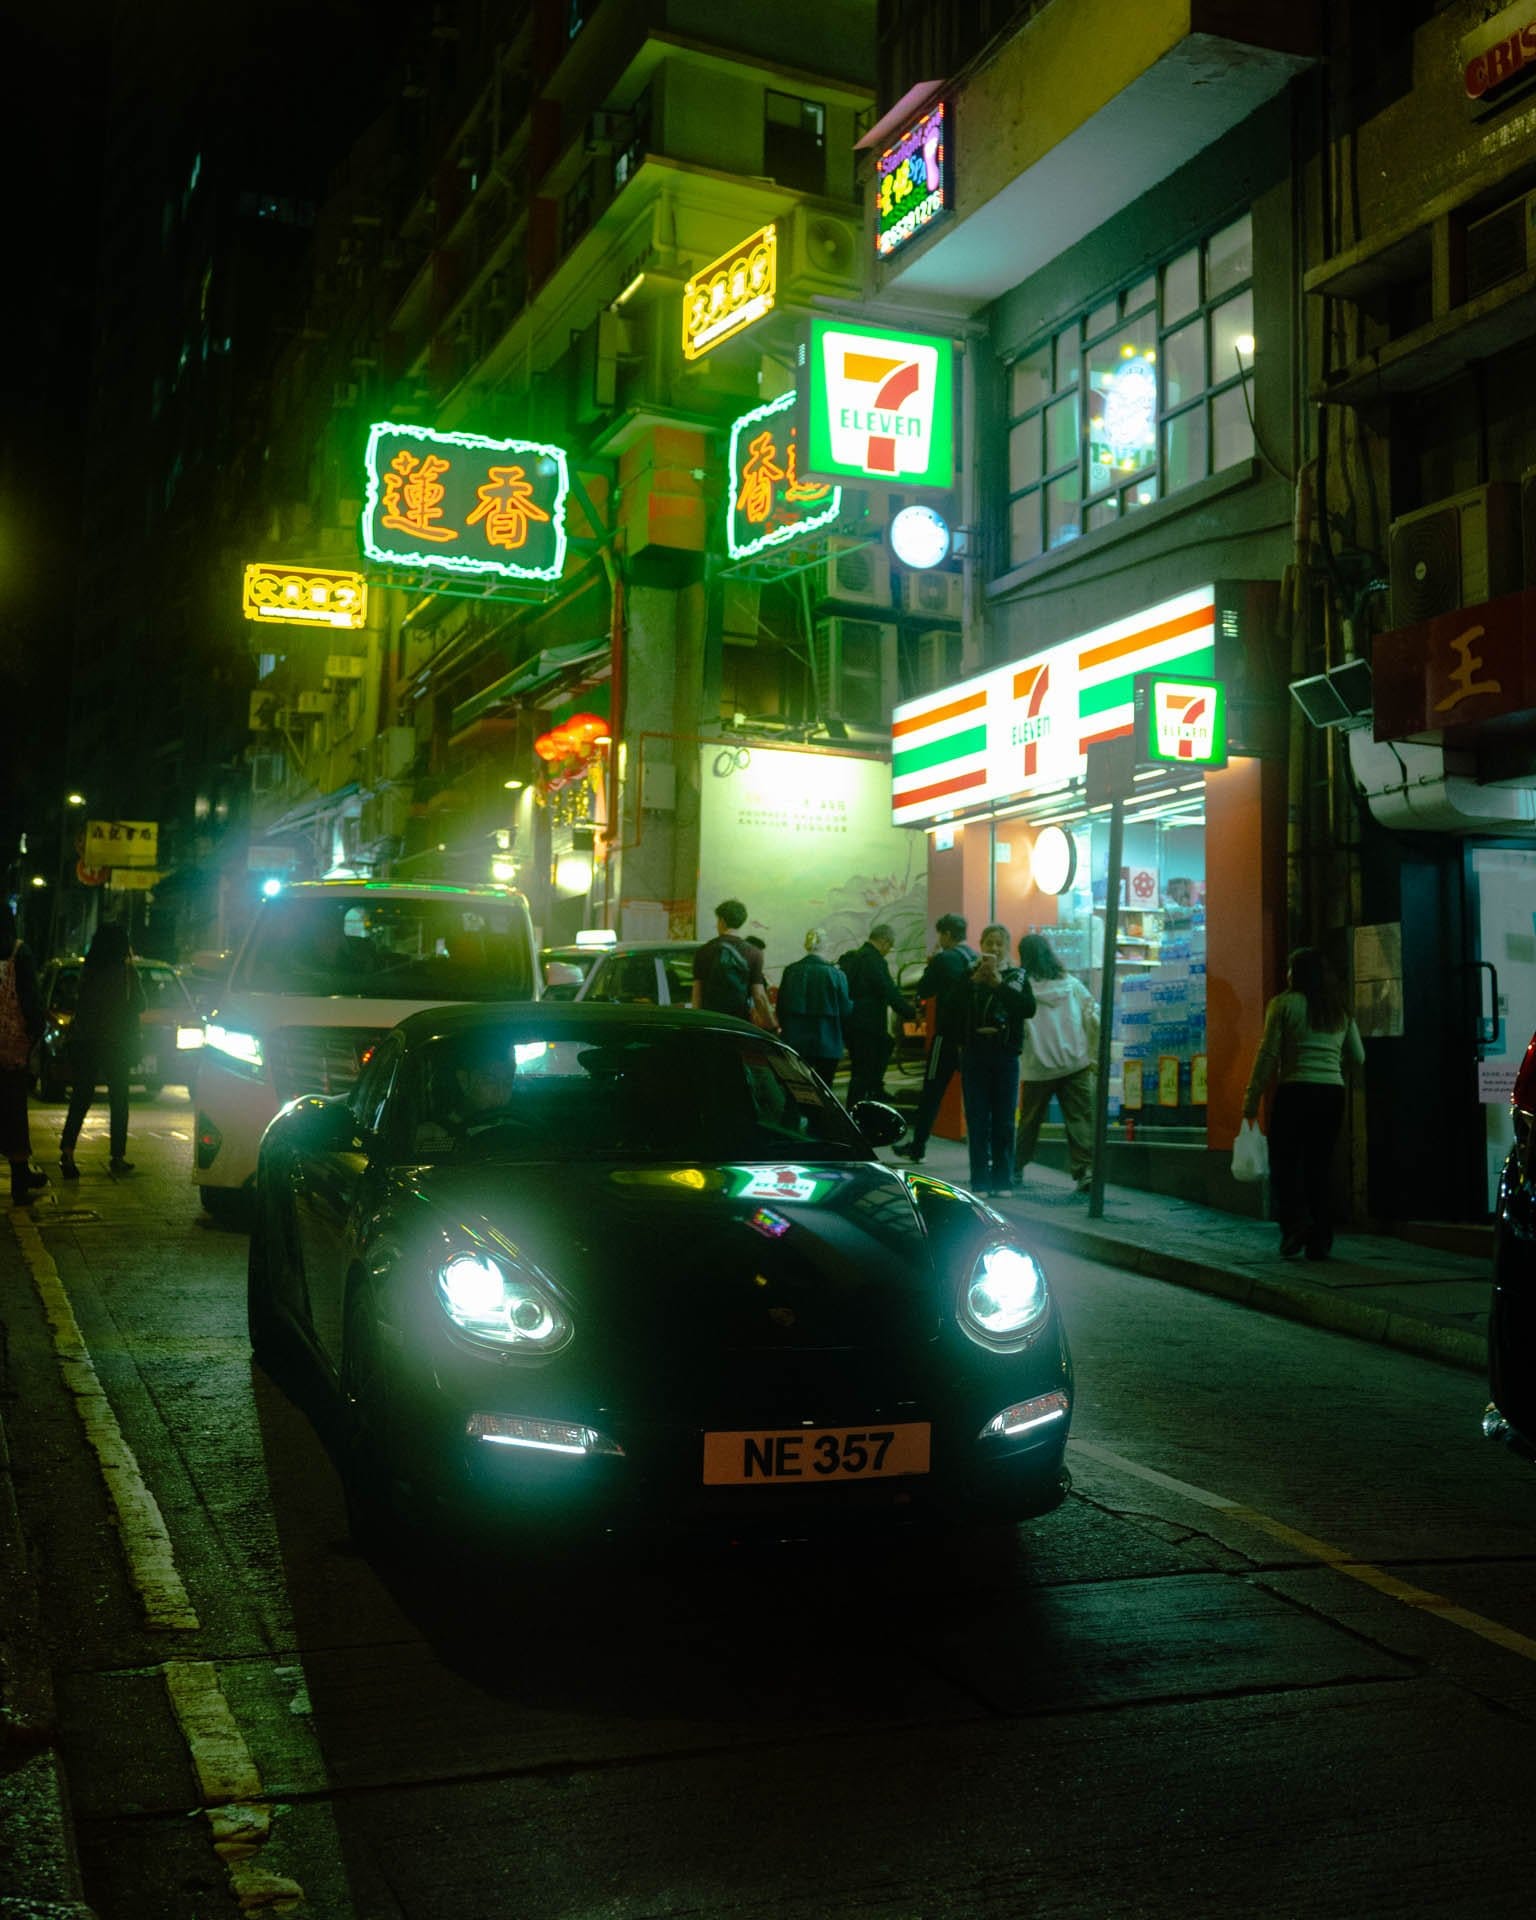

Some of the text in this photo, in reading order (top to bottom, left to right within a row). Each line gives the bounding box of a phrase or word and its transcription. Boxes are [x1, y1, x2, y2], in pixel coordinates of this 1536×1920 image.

[844, 352, 919, 471] 7
[382, 451, 550, 550] 蓮香
[1433, 625, 1501, 711] 王
[1013, 664, 1049, 776] 7
[1166, 694, 1206, 757] 7
[744, 1431, 895, 1478] NE 357
